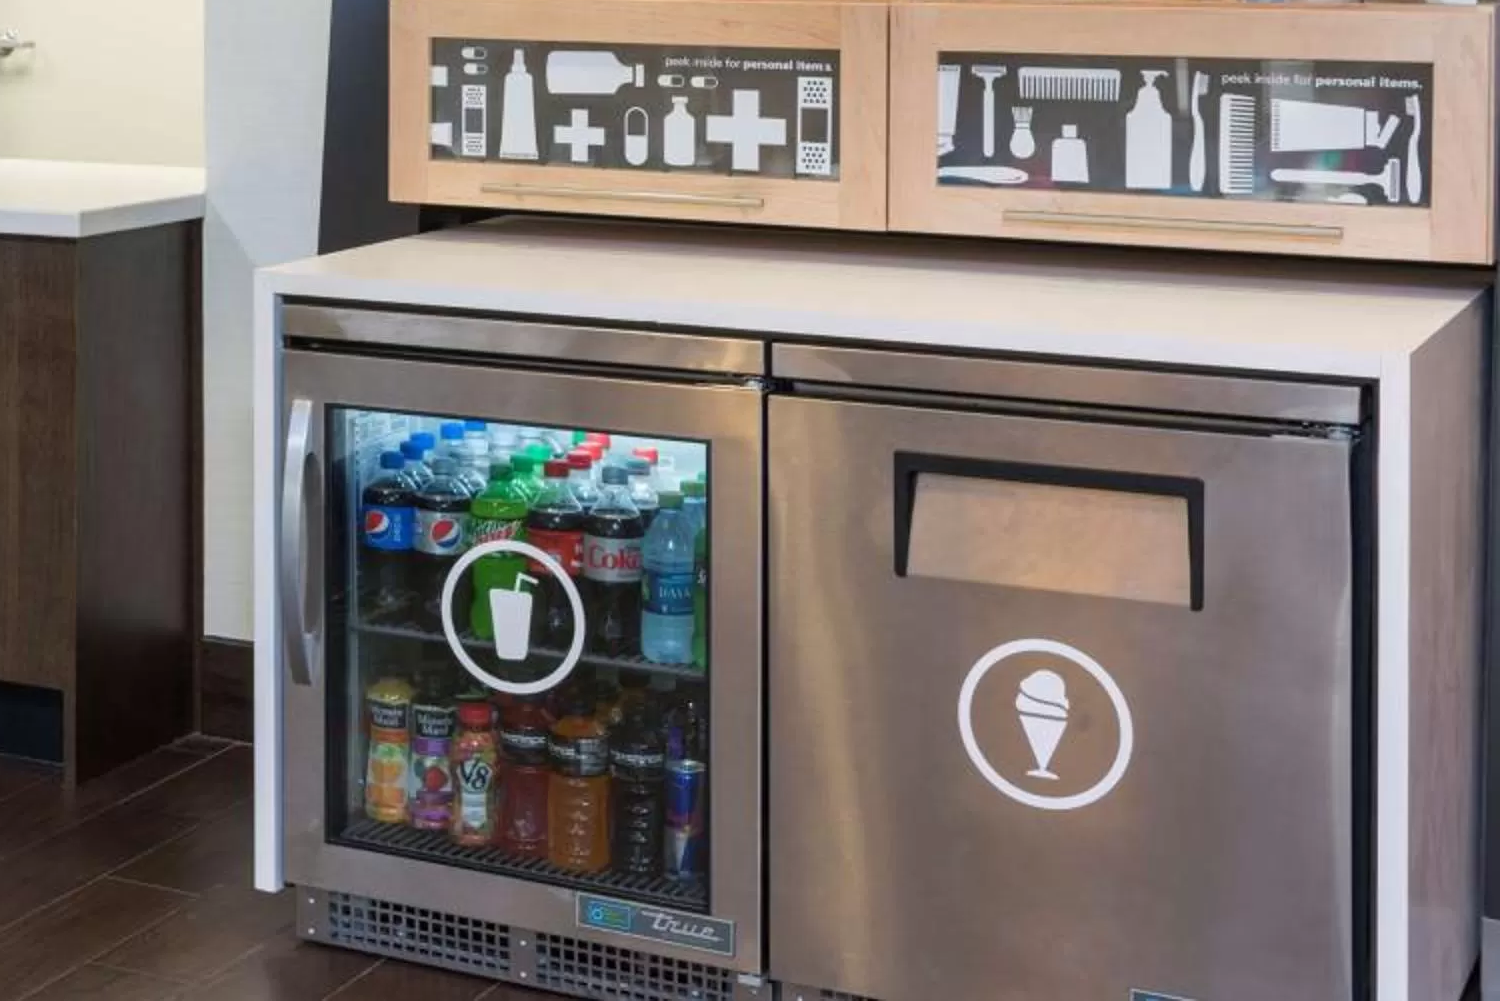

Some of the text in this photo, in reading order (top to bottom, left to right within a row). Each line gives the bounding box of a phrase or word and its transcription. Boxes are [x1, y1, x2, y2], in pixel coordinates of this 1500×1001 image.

[665, 57, 690, 68] peek
[725, 57, 741, 69] for
[743, 59, 793, 71] personal
[1220, 73, 1251, 86] peek
[1293, 74, 1312, 86] for
[1315, 76, 1375, 88] personal
[589, 540, 642, 569] Coke
[459, 756, 490, 791] V8
[641, 910, 724, 942] true
